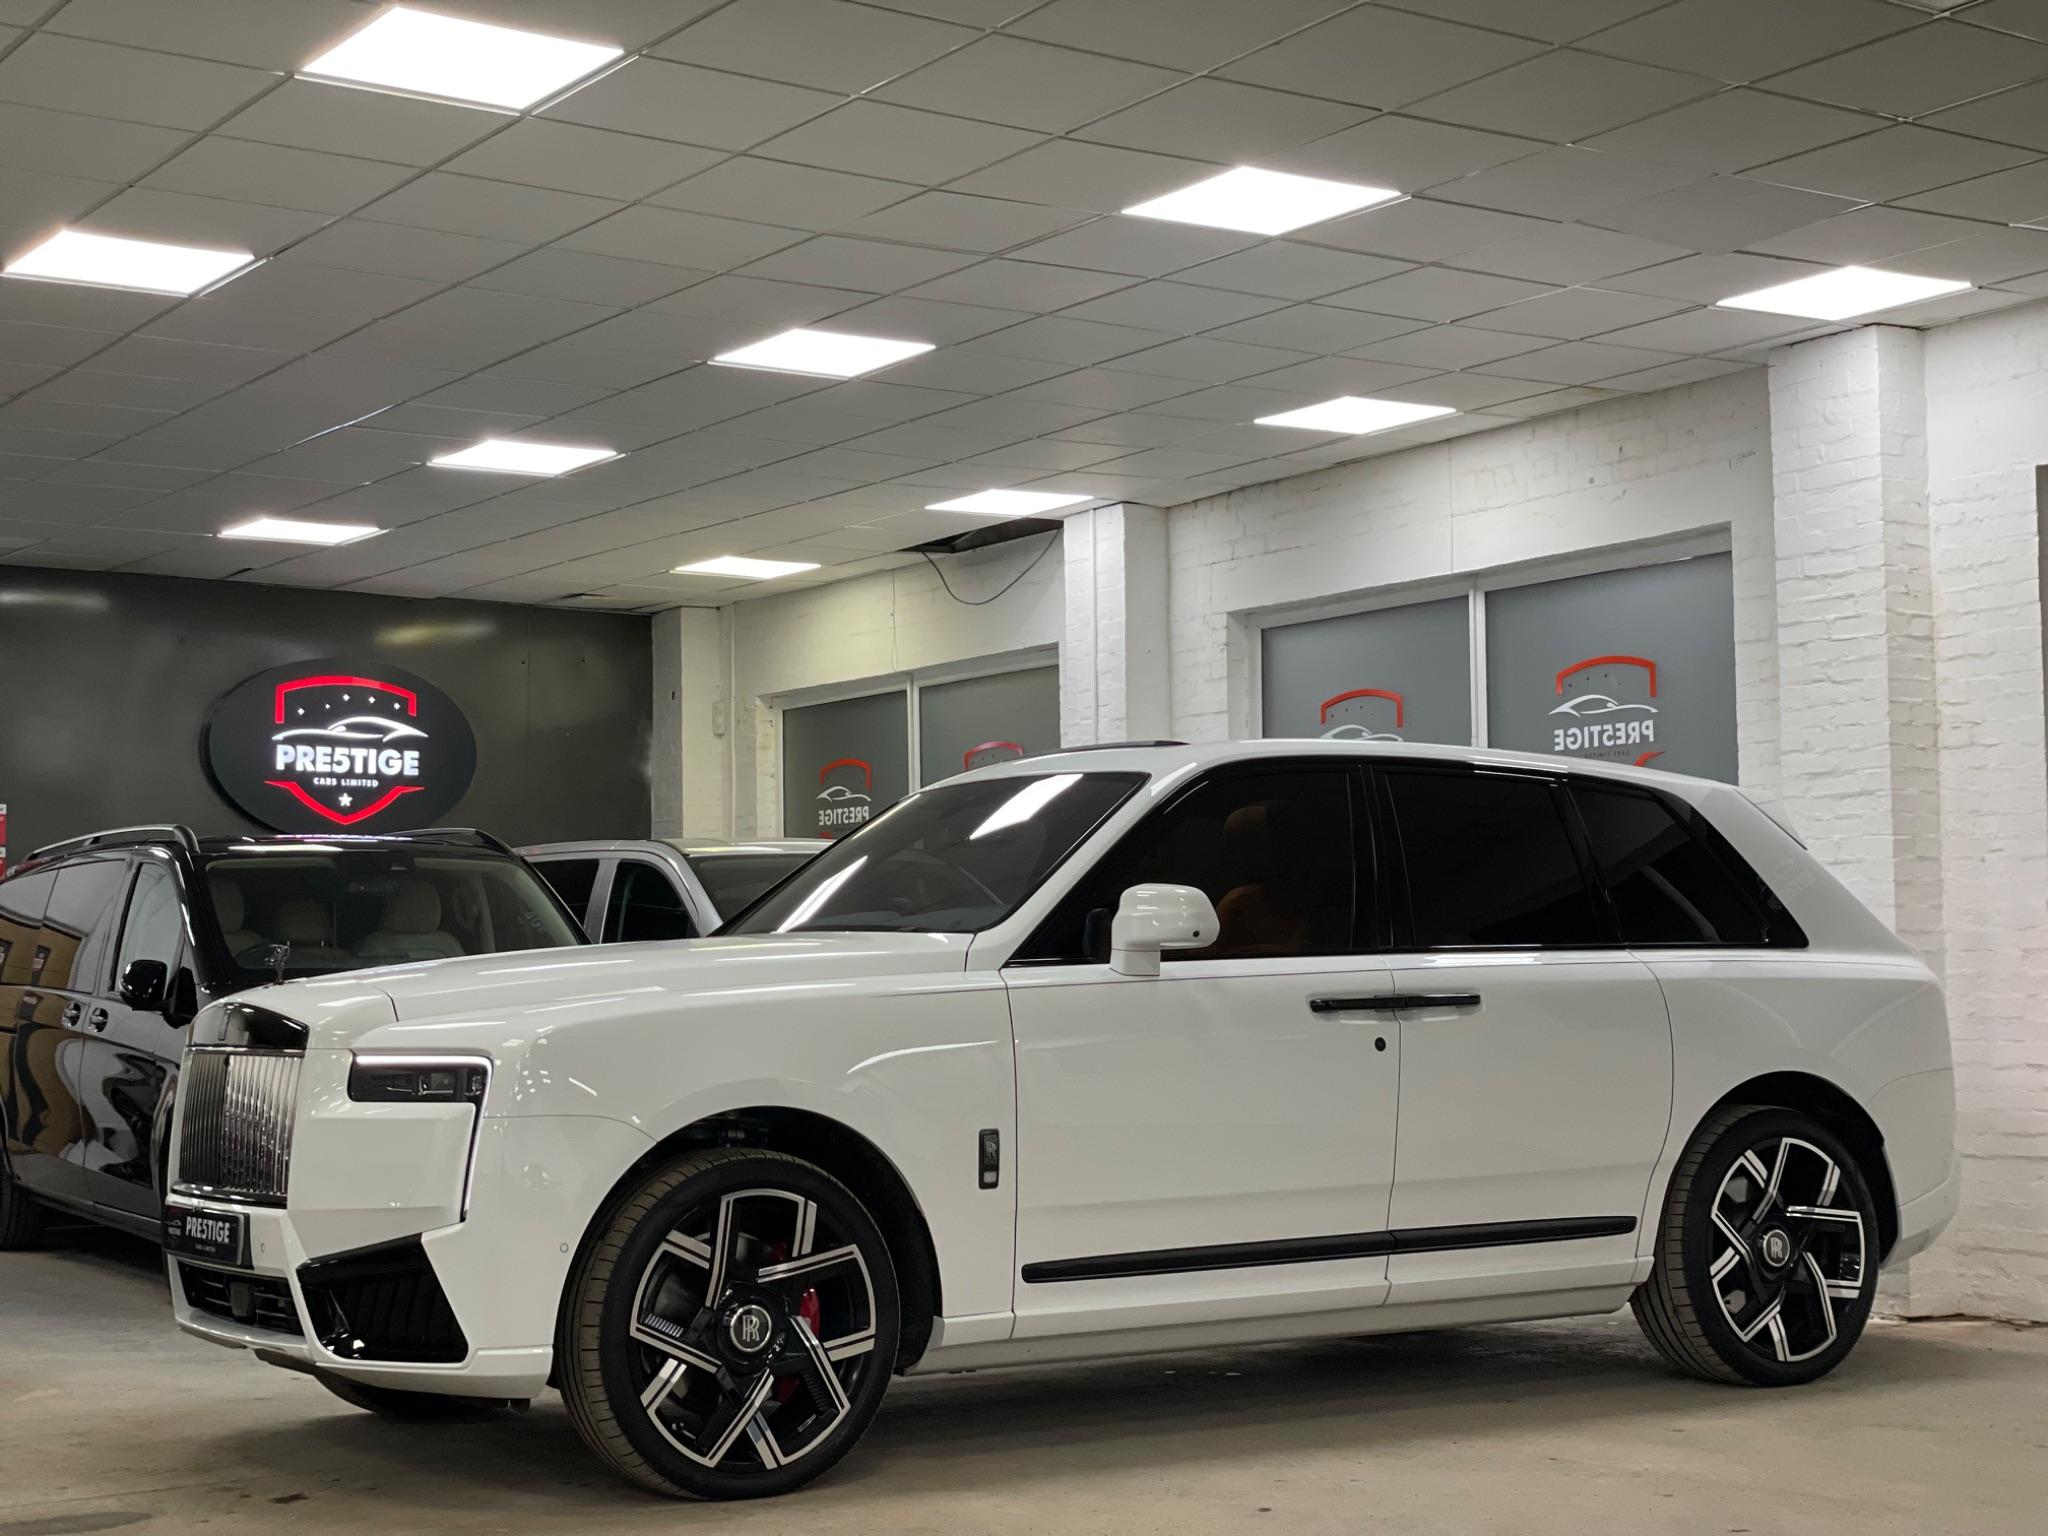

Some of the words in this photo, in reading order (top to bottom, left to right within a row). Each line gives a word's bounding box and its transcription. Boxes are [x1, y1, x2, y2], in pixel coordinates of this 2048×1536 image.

[275, 744, 420, 776] PRE5TIGE
[313, 777, 337, 786] CARS
[341, 778, 379, 788] LIMITED
